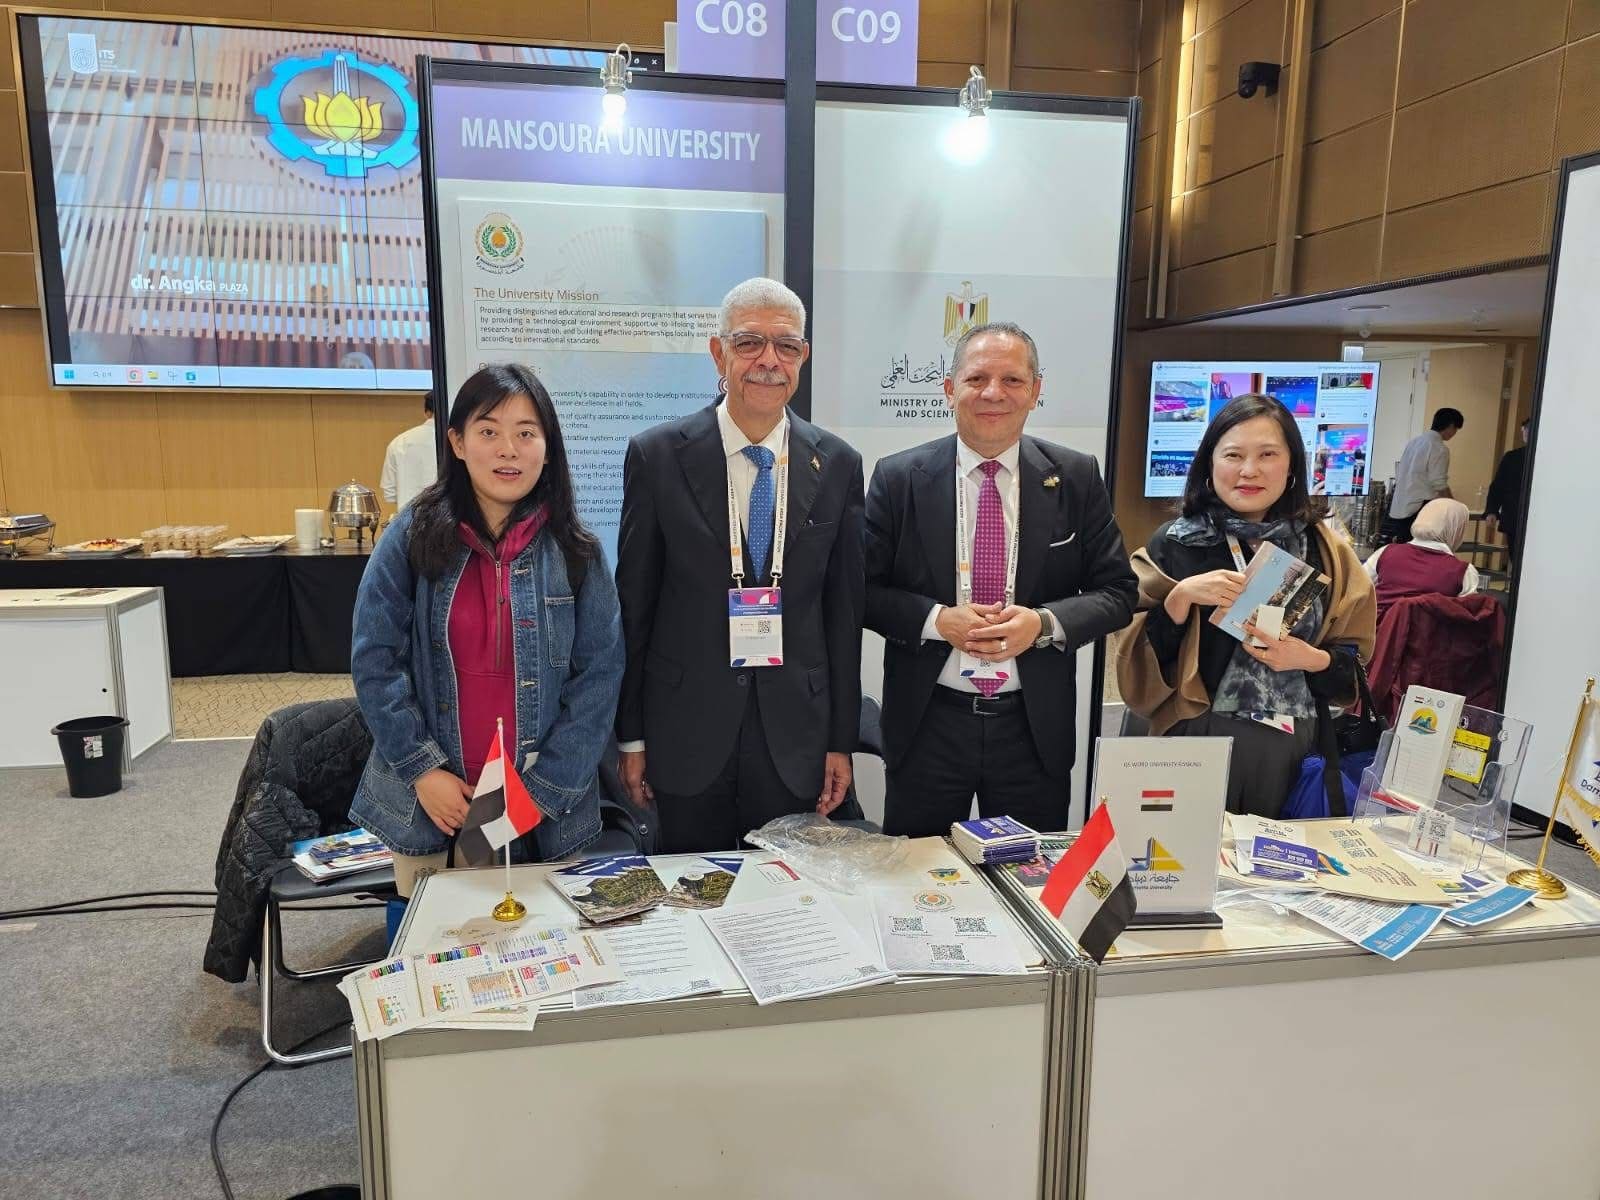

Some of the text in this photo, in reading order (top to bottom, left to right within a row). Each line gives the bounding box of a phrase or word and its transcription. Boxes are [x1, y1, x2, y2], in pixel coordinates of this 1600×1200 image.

[695, 0, 767, 37] C08
[831, 7, 901, 44] C09
[99, 50, 115, 59] ITS
[461, 117, 761, 161] MANSOURA UNIVERSITY
[131, 274, 248, 295] dr. Angka PLAZA
[474, 288, 599, 303] The University Mission
[480, 306, 511, 316] Providing
[513, 308, 557, 317] distinguished
[559, 308, 597, 317] educational
[597, 309, 611, 317] and
[612, 310, 639, 318] research
[641, 311, 672, 320] programs
[673, 311, 687, 319] that
[480, 316, 488, 324] by
[491, 317, 523, 326] providing
[533, 318, 577, 326] technological
[579, 319, 621, 327] environment
[577, 328, 603, 336] building
[603, 328, 632, 336] effective
[633, 330, 674, 338] partnerships
[674, 330, 695, 338] locally
[481, 335, 514, 344] according
[566, 337, 601, 345] standards.
[589, 390, 619, 400] capability
[655, 392, 679, 400] develop
[880, 399, 944, 407] MINISTRY OF
[574, 413, 597, 421] quality
[896, 409, 954, 418] AND SCIENT
[1149, 872, 1180, 884] جامعة
